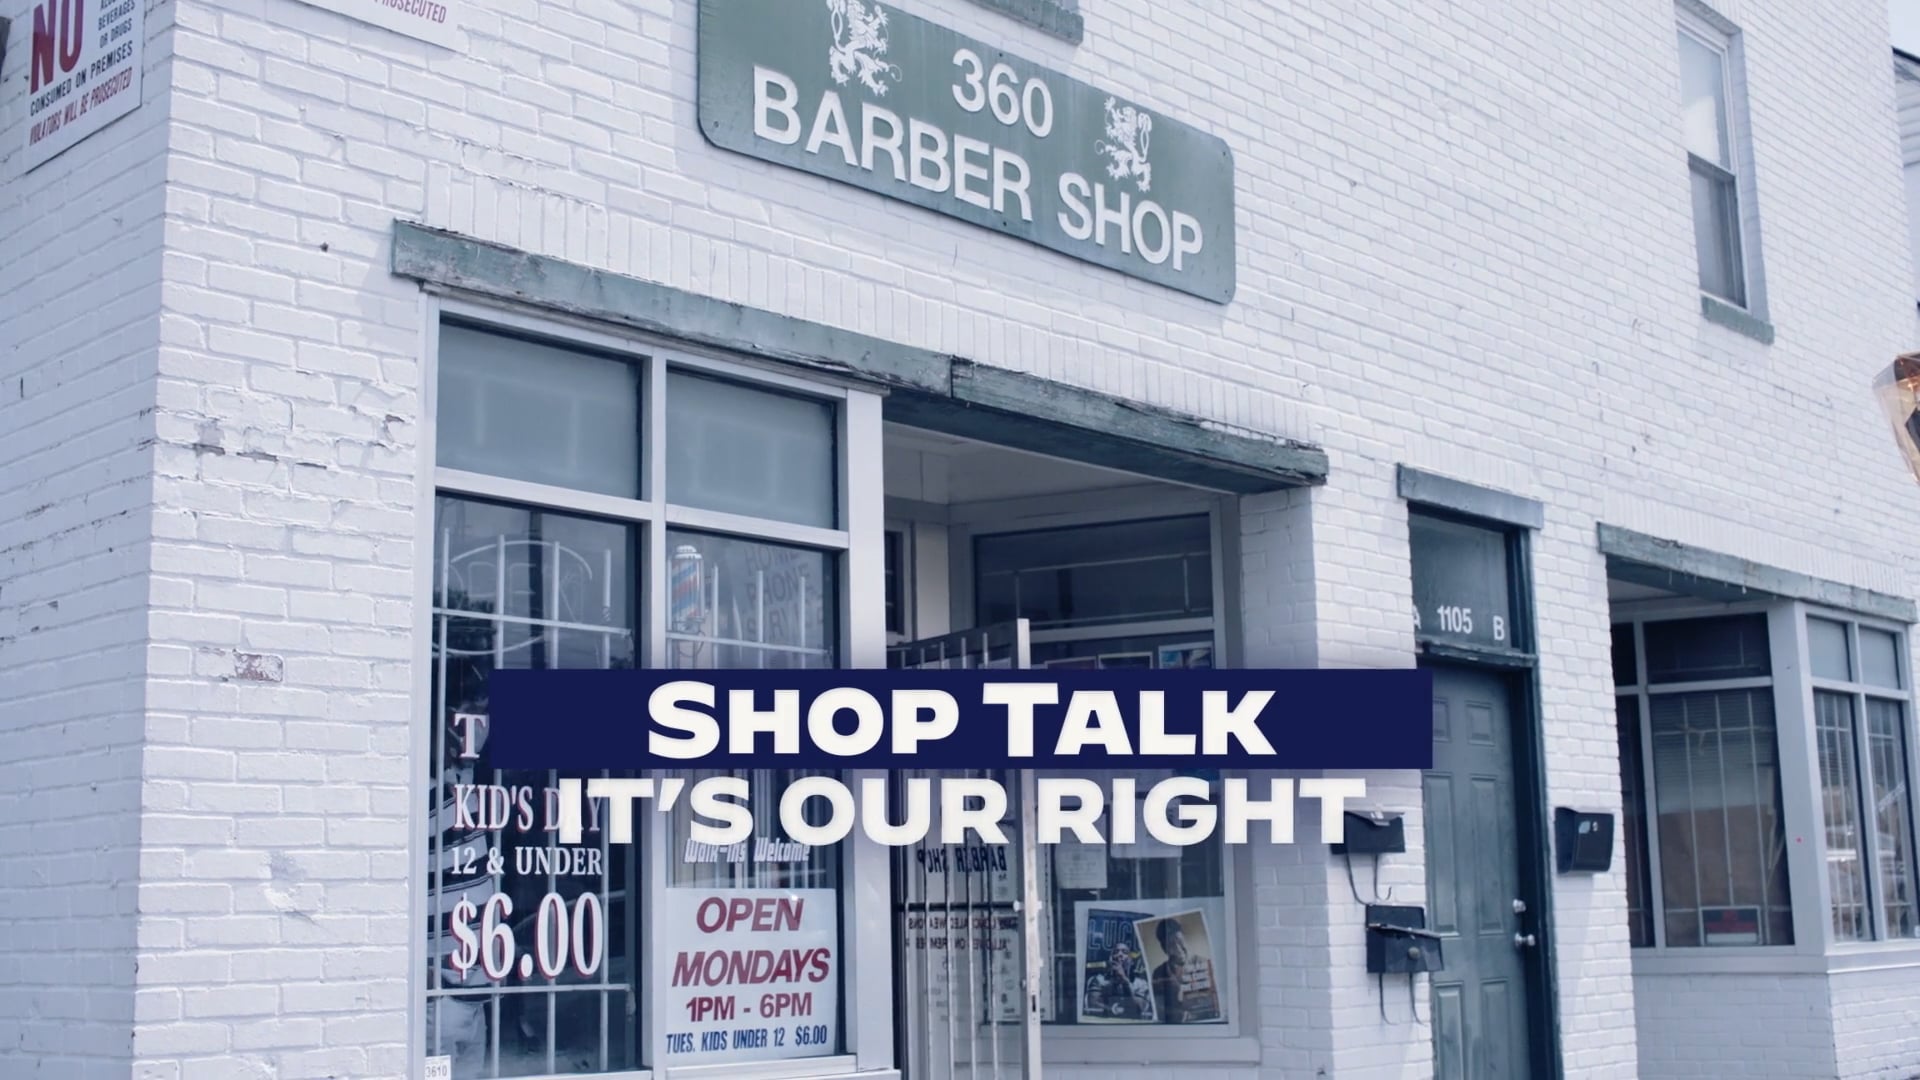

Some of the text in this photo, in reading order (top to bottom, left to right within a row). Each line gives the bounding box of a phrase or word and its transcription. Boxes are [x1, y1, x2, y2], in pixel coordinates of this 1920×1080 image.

[30, 0, 84, 95] NO
[30, 40, 133, 117] CONSUMED ON PREMISES
[952, 48, 1053, 137] 360
[29, 110, 62, 146] VIOLATORS
[63, 100, 78, 125] WILL
[90, 66, 133, 110] PROSECUTED
[752, 64, 1203, 272] BARBER SHOP
[1437, 605, 1473, 634] 1105
[1493, 615, 1505, 640] B
[453, 784, 602, 832] KID'S DY
[451, 846, 603, 876] 12 & UNDER
[449, 892, 603, 980] $6.00
[696, 897, 804, 933] OPEN
[672, 948, 831, 987] MONDAYS
[686, 996, 735, 1022] 1PM
[759, 992, 812, 1018] 6PM
[666, 1024, 828, 1054] TUES. KIDS UNDER 12 $6.00
